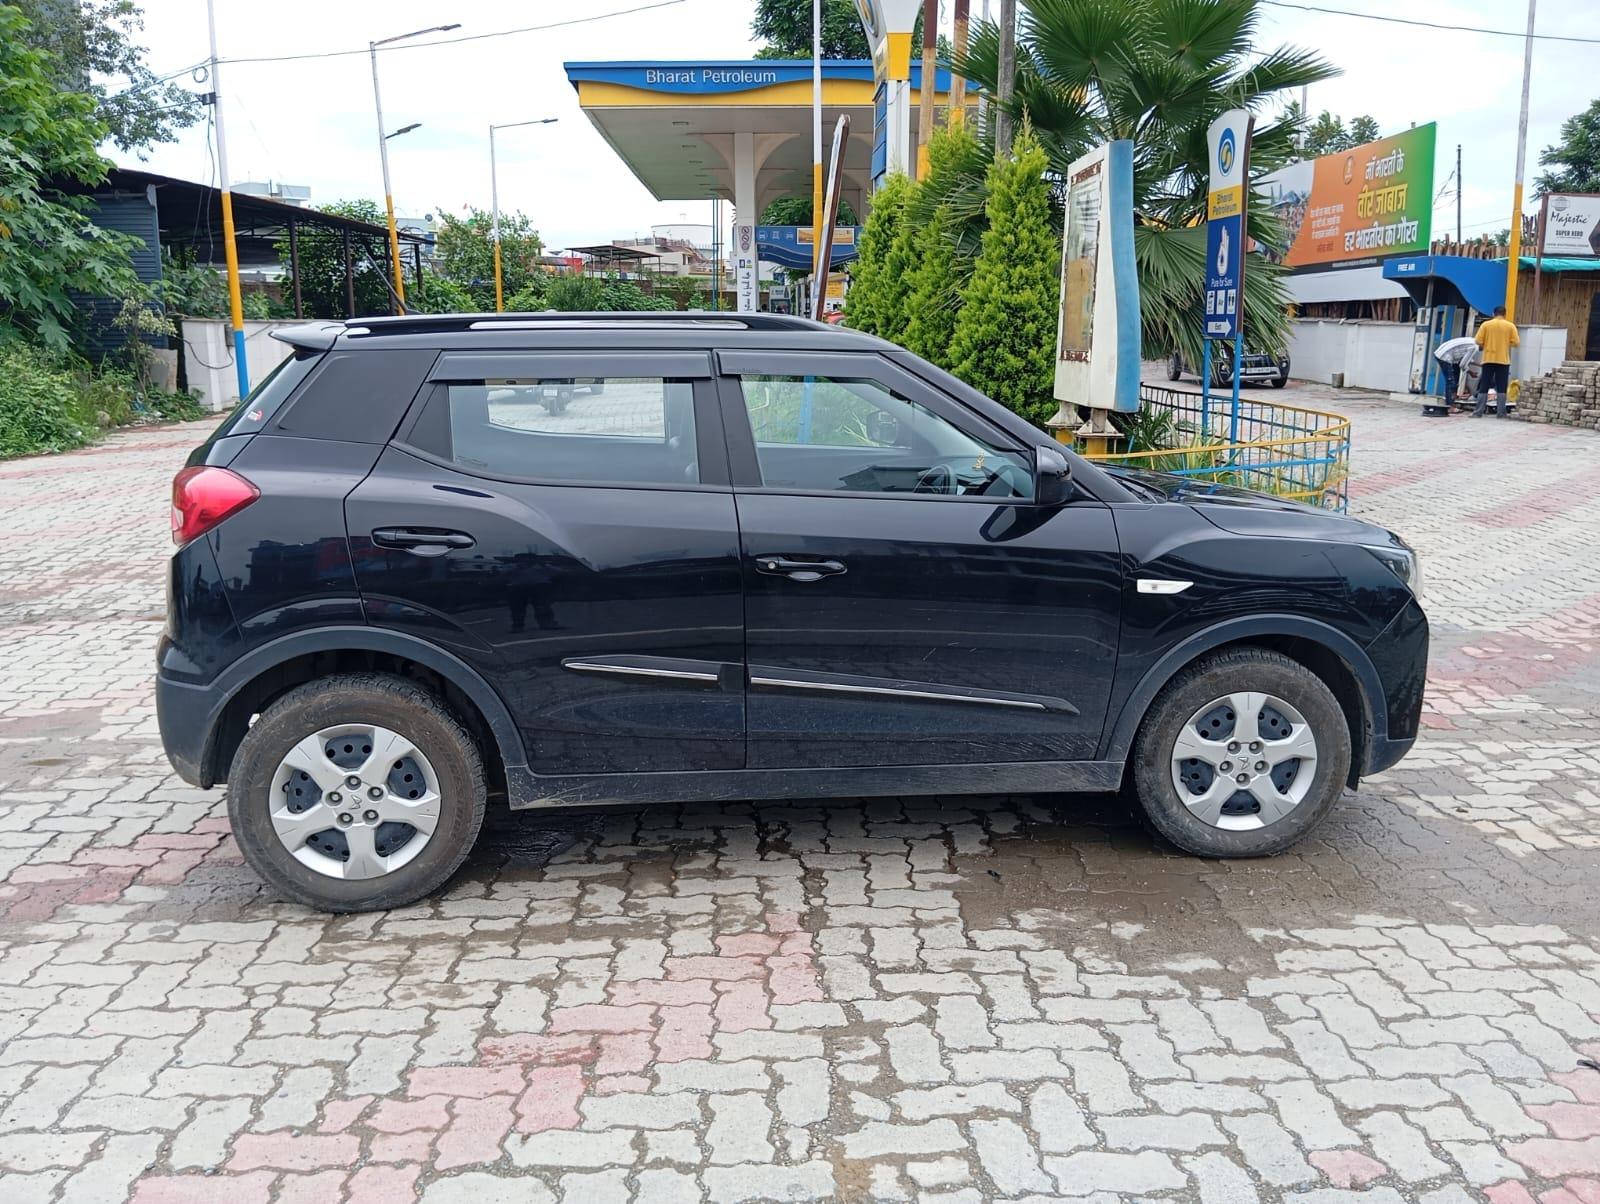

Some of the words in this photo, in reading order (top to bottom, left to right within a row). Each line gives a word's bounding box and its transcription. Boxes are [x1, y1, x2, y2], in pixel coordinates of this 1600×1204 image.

[646, 69, 696, 83] Bharat
[703, 69, 776, 83] Petroleum
[1376, 152, 1396, 178] भारती
[1396, 148, 1405, 174] के
[1216, 192, 1233, 204] Bharat
[1357, 184, 1375, 219] वीर
[1212, 203, 1237, 216] Petroleum
[1550, 211, 1588, 227] Majestic
[1345, 232, 1356, 252] हर
[1356, 221, 1384, 250] भारतीय
[1385, 223, 1396, 246] का
[1397, 217, 1419, 245] गौरव
[1397, 264, 1408, 273] FREE
